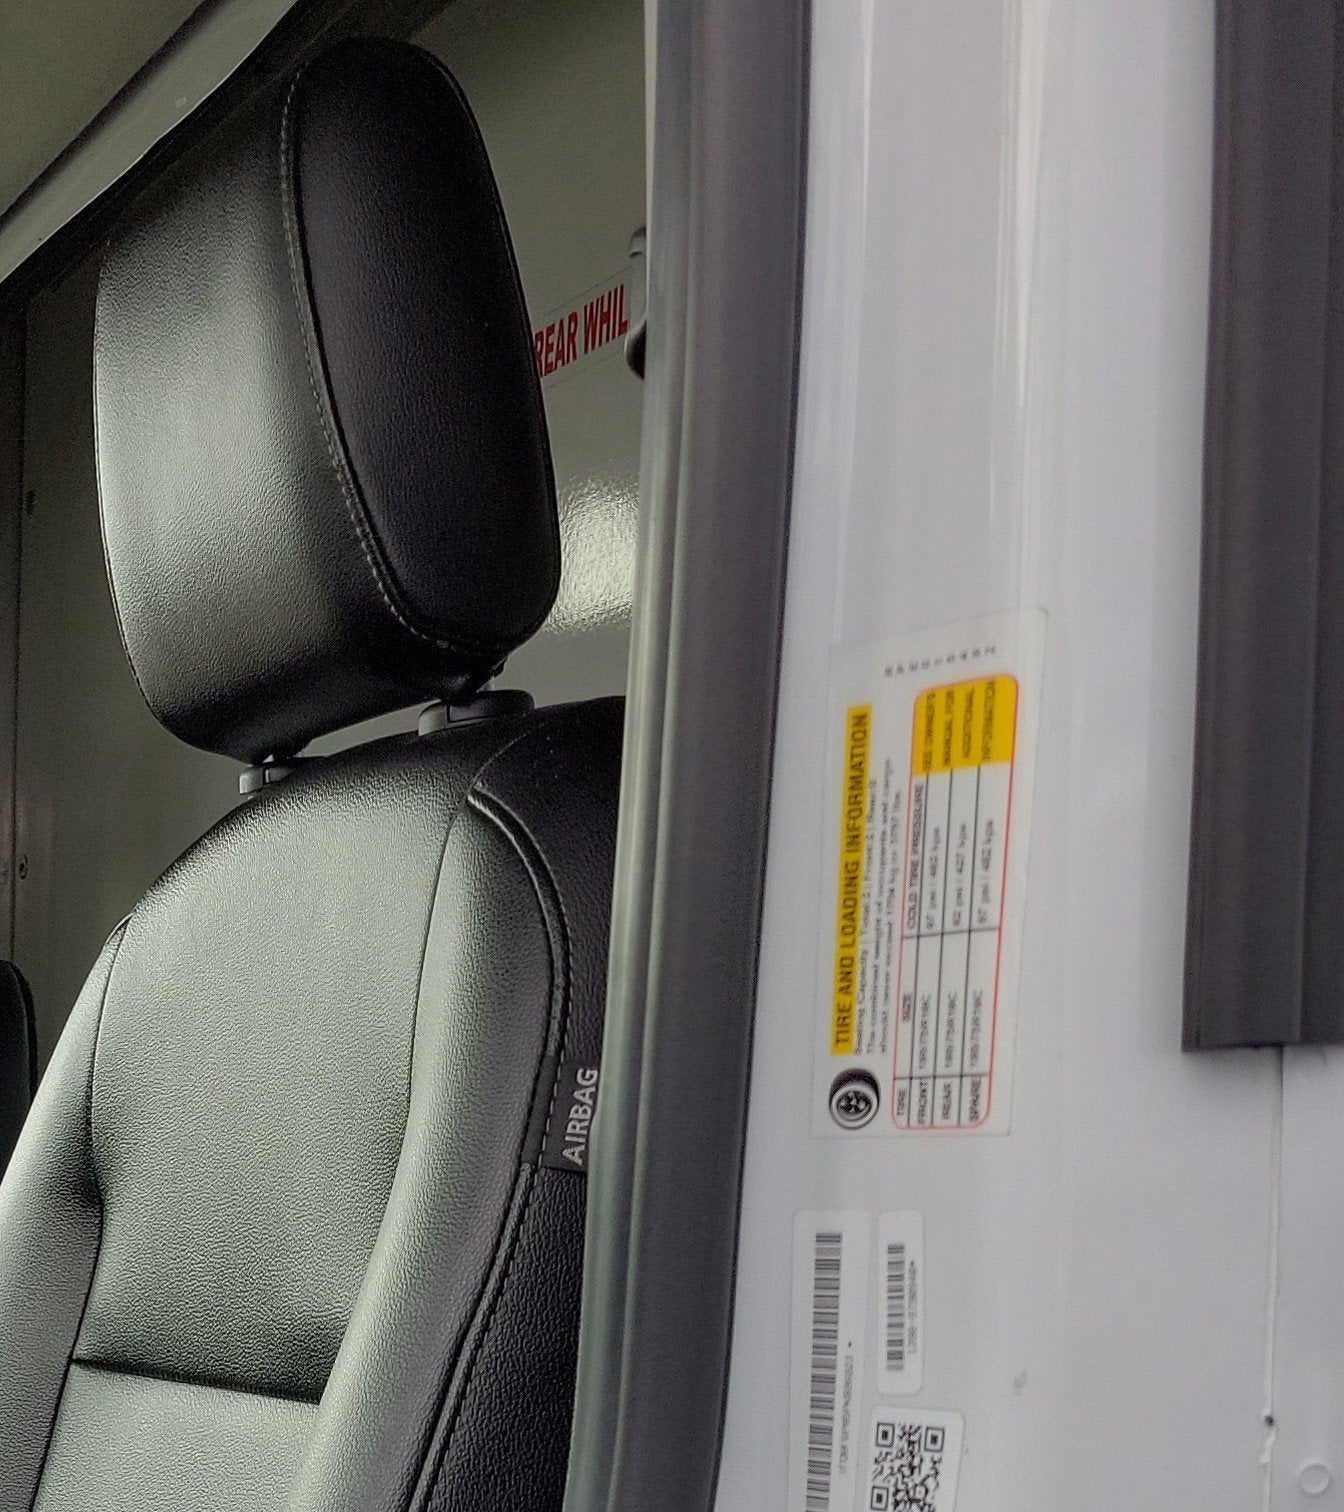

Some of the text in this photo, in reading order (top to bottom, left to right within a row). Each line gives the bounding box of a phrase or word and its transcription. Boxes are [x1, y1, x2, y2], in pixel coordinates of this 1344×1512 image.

[534, 311, 579, 378] REAR
[834, 713, 868, 1044] TIRE AND LOADING INFORMATION
[562, 1068, 598, 1166] AIRBAG
